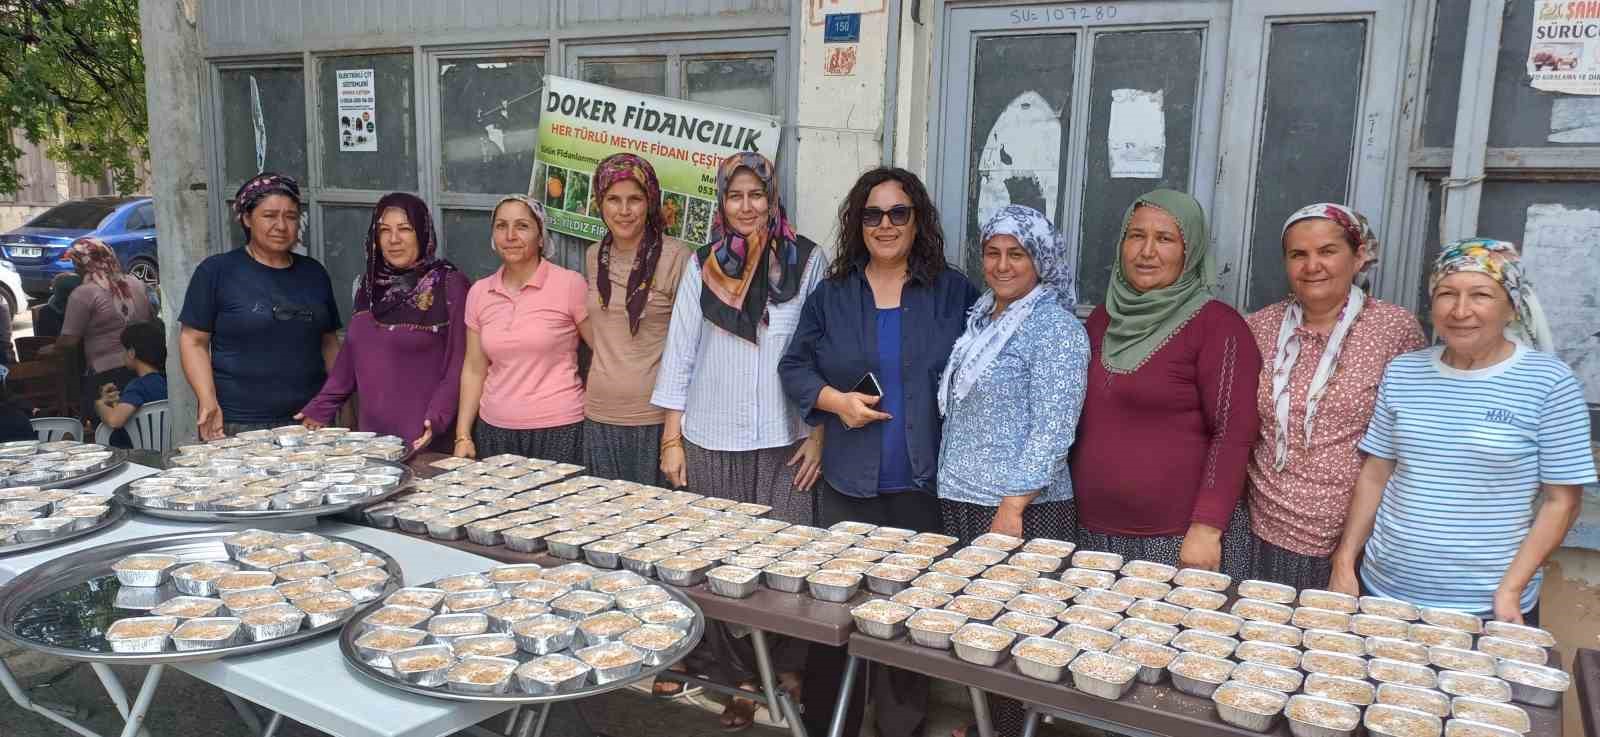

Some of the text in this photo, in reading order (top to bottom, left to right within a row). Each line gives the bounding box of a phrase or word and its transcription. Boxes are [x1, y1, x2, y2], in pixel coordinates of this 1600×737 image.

[1046, 6, 1118, 22] 107280
[1536, 21, 1600, 40] SÜRÜC
[546, 91, 762, 153] DOKER FİDANCILIK
[551, 123, 573, 137] HER
[575, 126, 608, 144] TÜRLÜ
[610, 134, 650, 153] MEYVE
[650, 139, 689, 161] FİDANI
